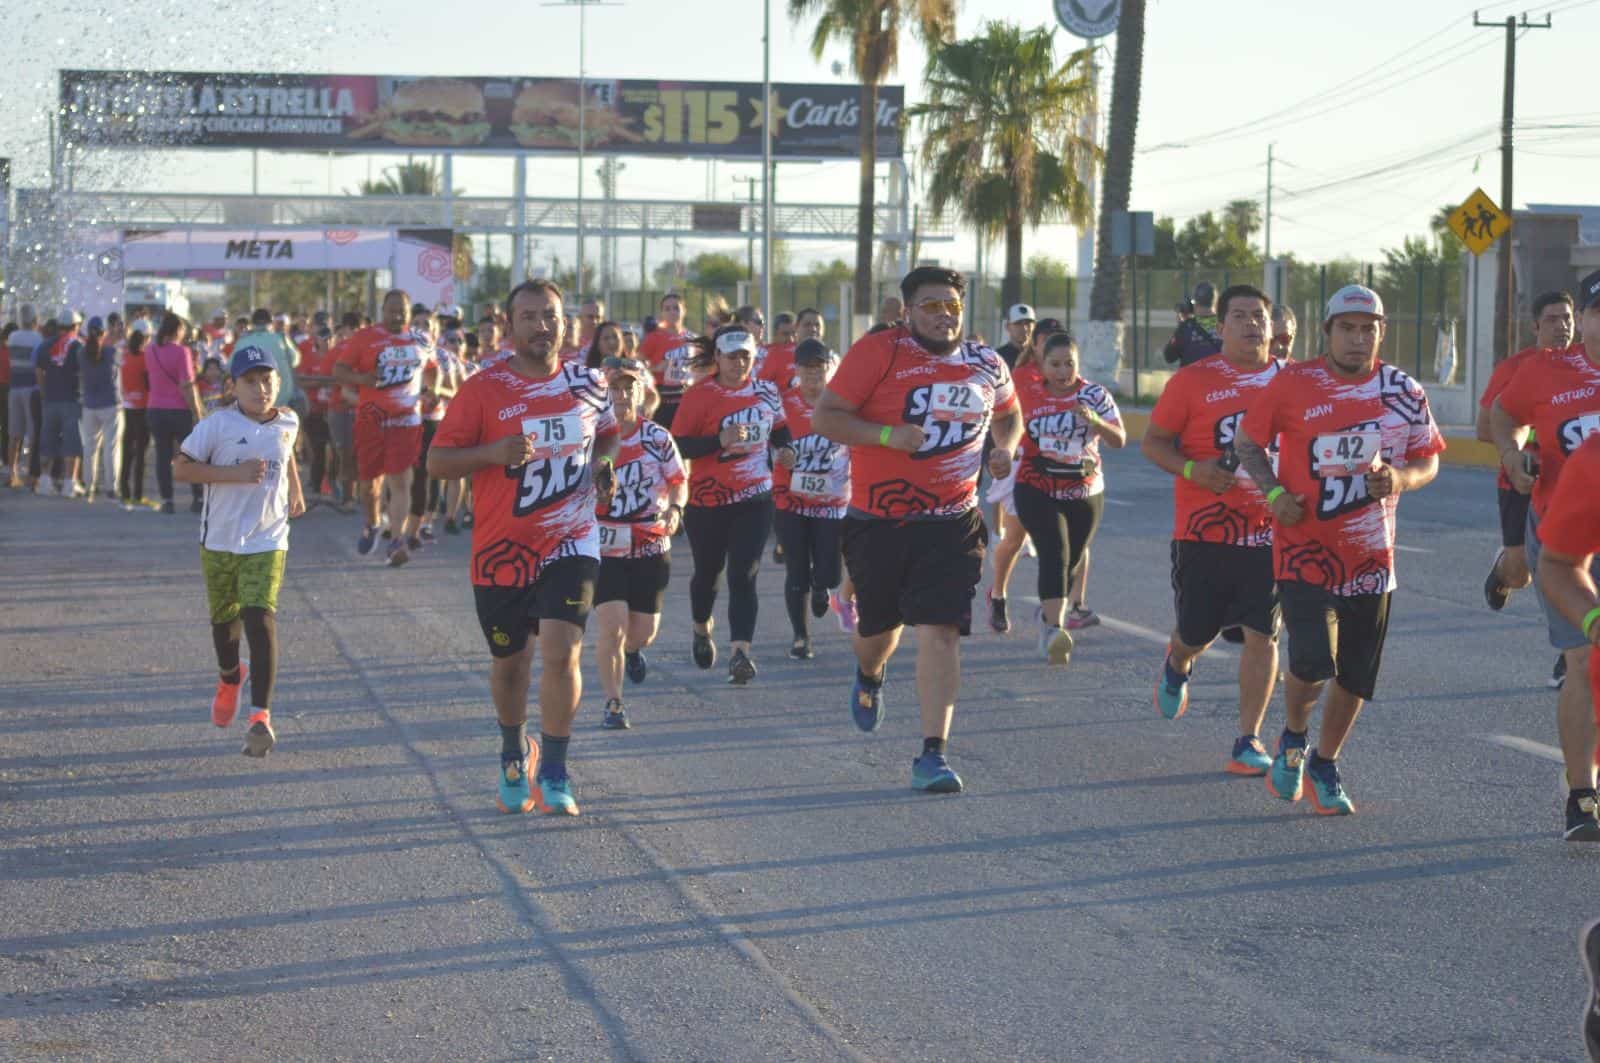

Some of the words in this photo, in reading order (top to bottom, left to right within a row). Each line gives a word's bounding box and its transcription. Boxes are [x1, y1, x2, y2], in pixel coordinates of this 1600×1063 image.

[223, 87, 355, 115] ESTRELLA
[644, 90, 739, 144] $115
[786, 97, 860, 128] Carl's
[225, 239, 294, 259] META
[947, 386, 971, 408] 22
[1551, 387, 1596, 406] ARTURO
[498, 403, 528, 420] OBED
[1303, 403, 1333, 421] JUAN
[540, 417, 566, 442] 75
[1336, 436, 1364, 459] 42
[800, 476, 826, 493] 152
